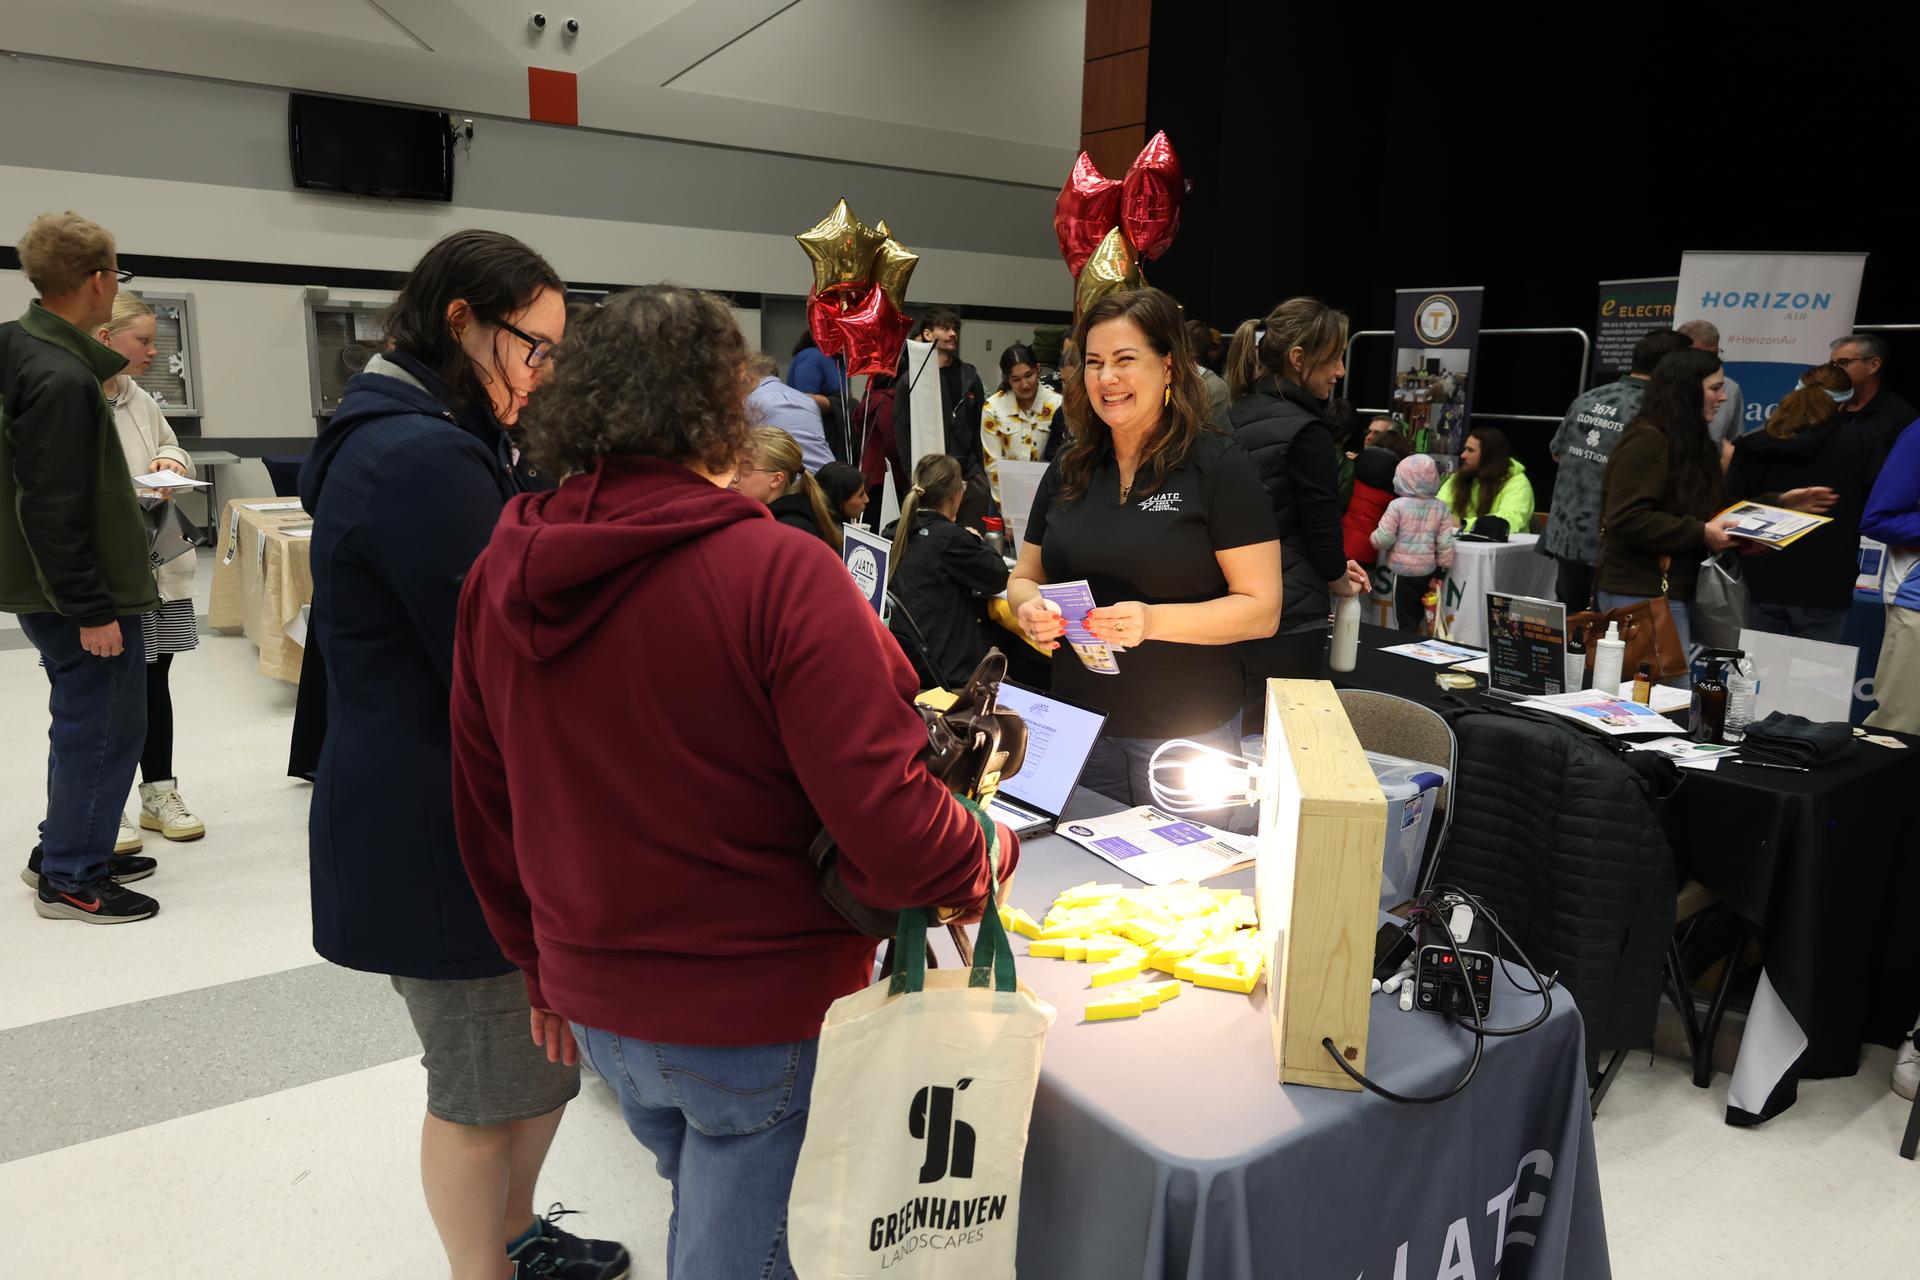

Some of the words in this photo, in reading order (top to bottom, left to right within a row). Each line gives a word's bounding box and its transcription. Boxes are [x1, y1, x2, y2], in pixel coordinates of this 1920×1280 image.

[1701, 291, 1833, 310] HORIZON
[1783, 312, 1808, 321] AIR
[1727, 335, 1799, 346] #HorizonAir
[1591, 403, 1618, 417] 3674
[1577, 413, 1625, 432] CLOVERBOTS
[1153, 492, 1180, 501] JATC
[858, 557, 874, 576] JATC
[869, 1195, 1007, 1251] GREENHAVEN
[881, 1228, 984, 1270] LANDSCAPES
